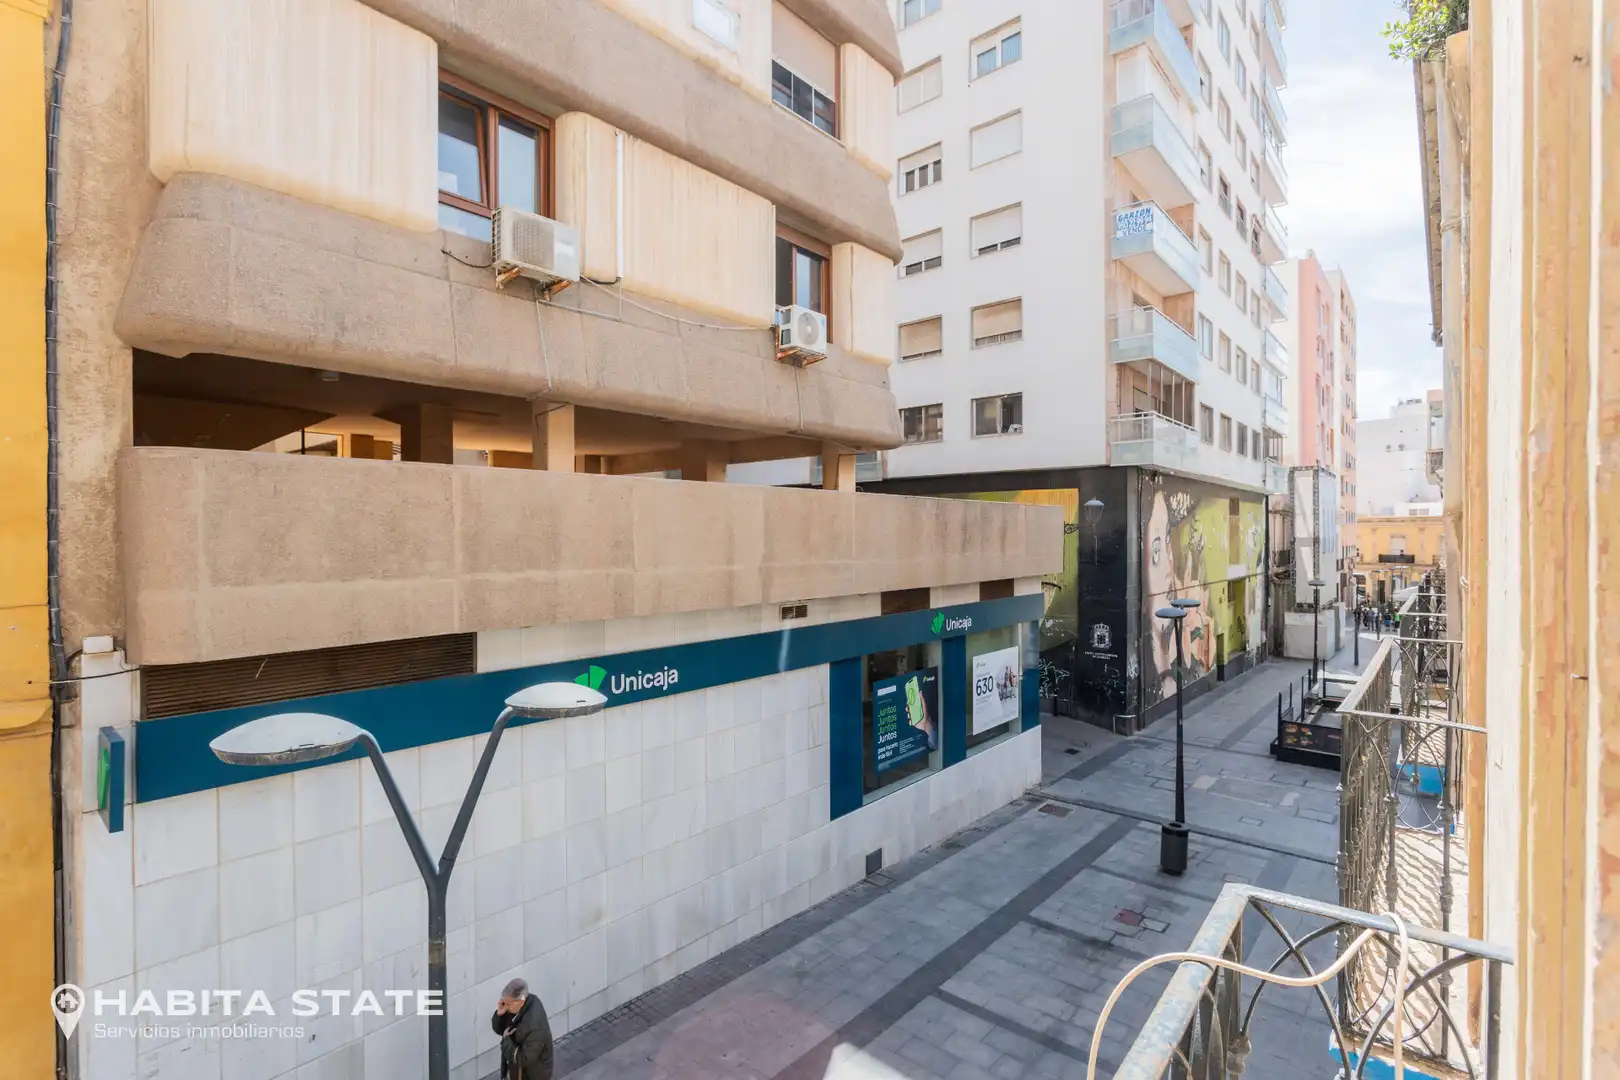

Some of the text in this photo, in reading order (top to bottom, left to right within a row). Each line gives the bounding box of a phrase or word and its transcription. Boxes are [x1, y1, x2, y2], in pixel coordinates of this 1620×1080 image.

[945, 616, 972, 631] Unicaja
[611, 665, 679, 694] Unicaja
[976, 676, 993, 696] 630
[878, 706, 897, 718] Juntos
[878, 715, 897, 727] Juntos
[878, 724, 897, 735] Juntos
[878, 731, 898, 744] Juntos
